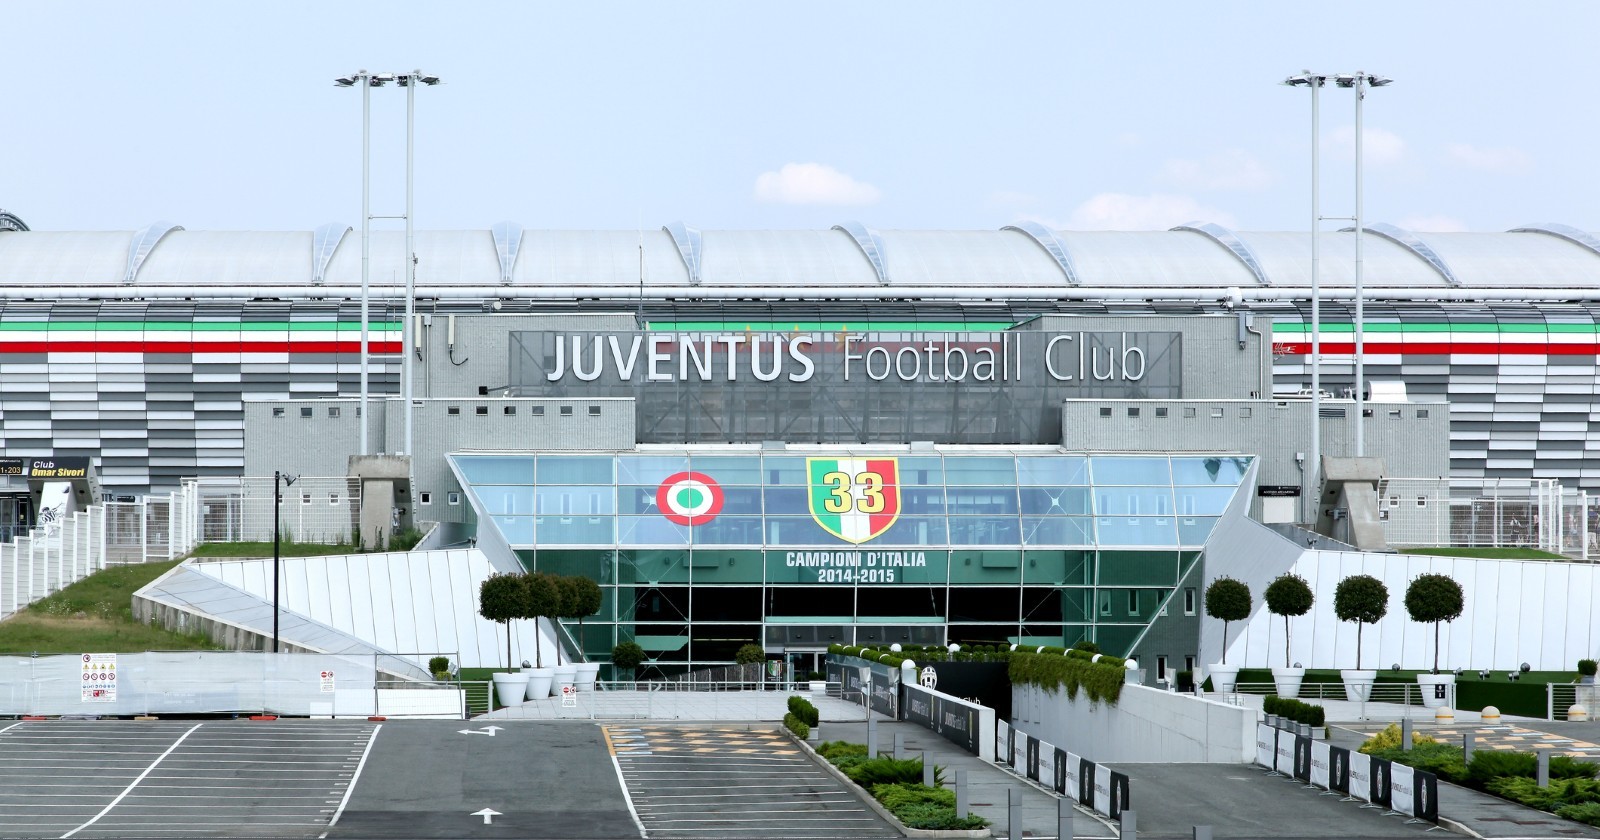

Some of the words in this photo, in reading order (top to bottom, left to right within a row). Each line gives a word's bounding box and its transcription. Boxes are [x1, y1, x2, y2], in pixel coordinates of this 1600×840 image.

[547, 335, 815, 382] JUVENTUS
[843, 331, 1021, 381] Football
[1045, 331, 1146, 381] Club
[31, 468, 56, 476] Omar
[57, 468, 84, 476] Sivori
[823, 472, 885, 513] 33
[786, 552, 862, 567] CAMPIONI
[867, 552, 926, 567] D'ITALIA
[818, 569, 895, 583] 2014-2015
